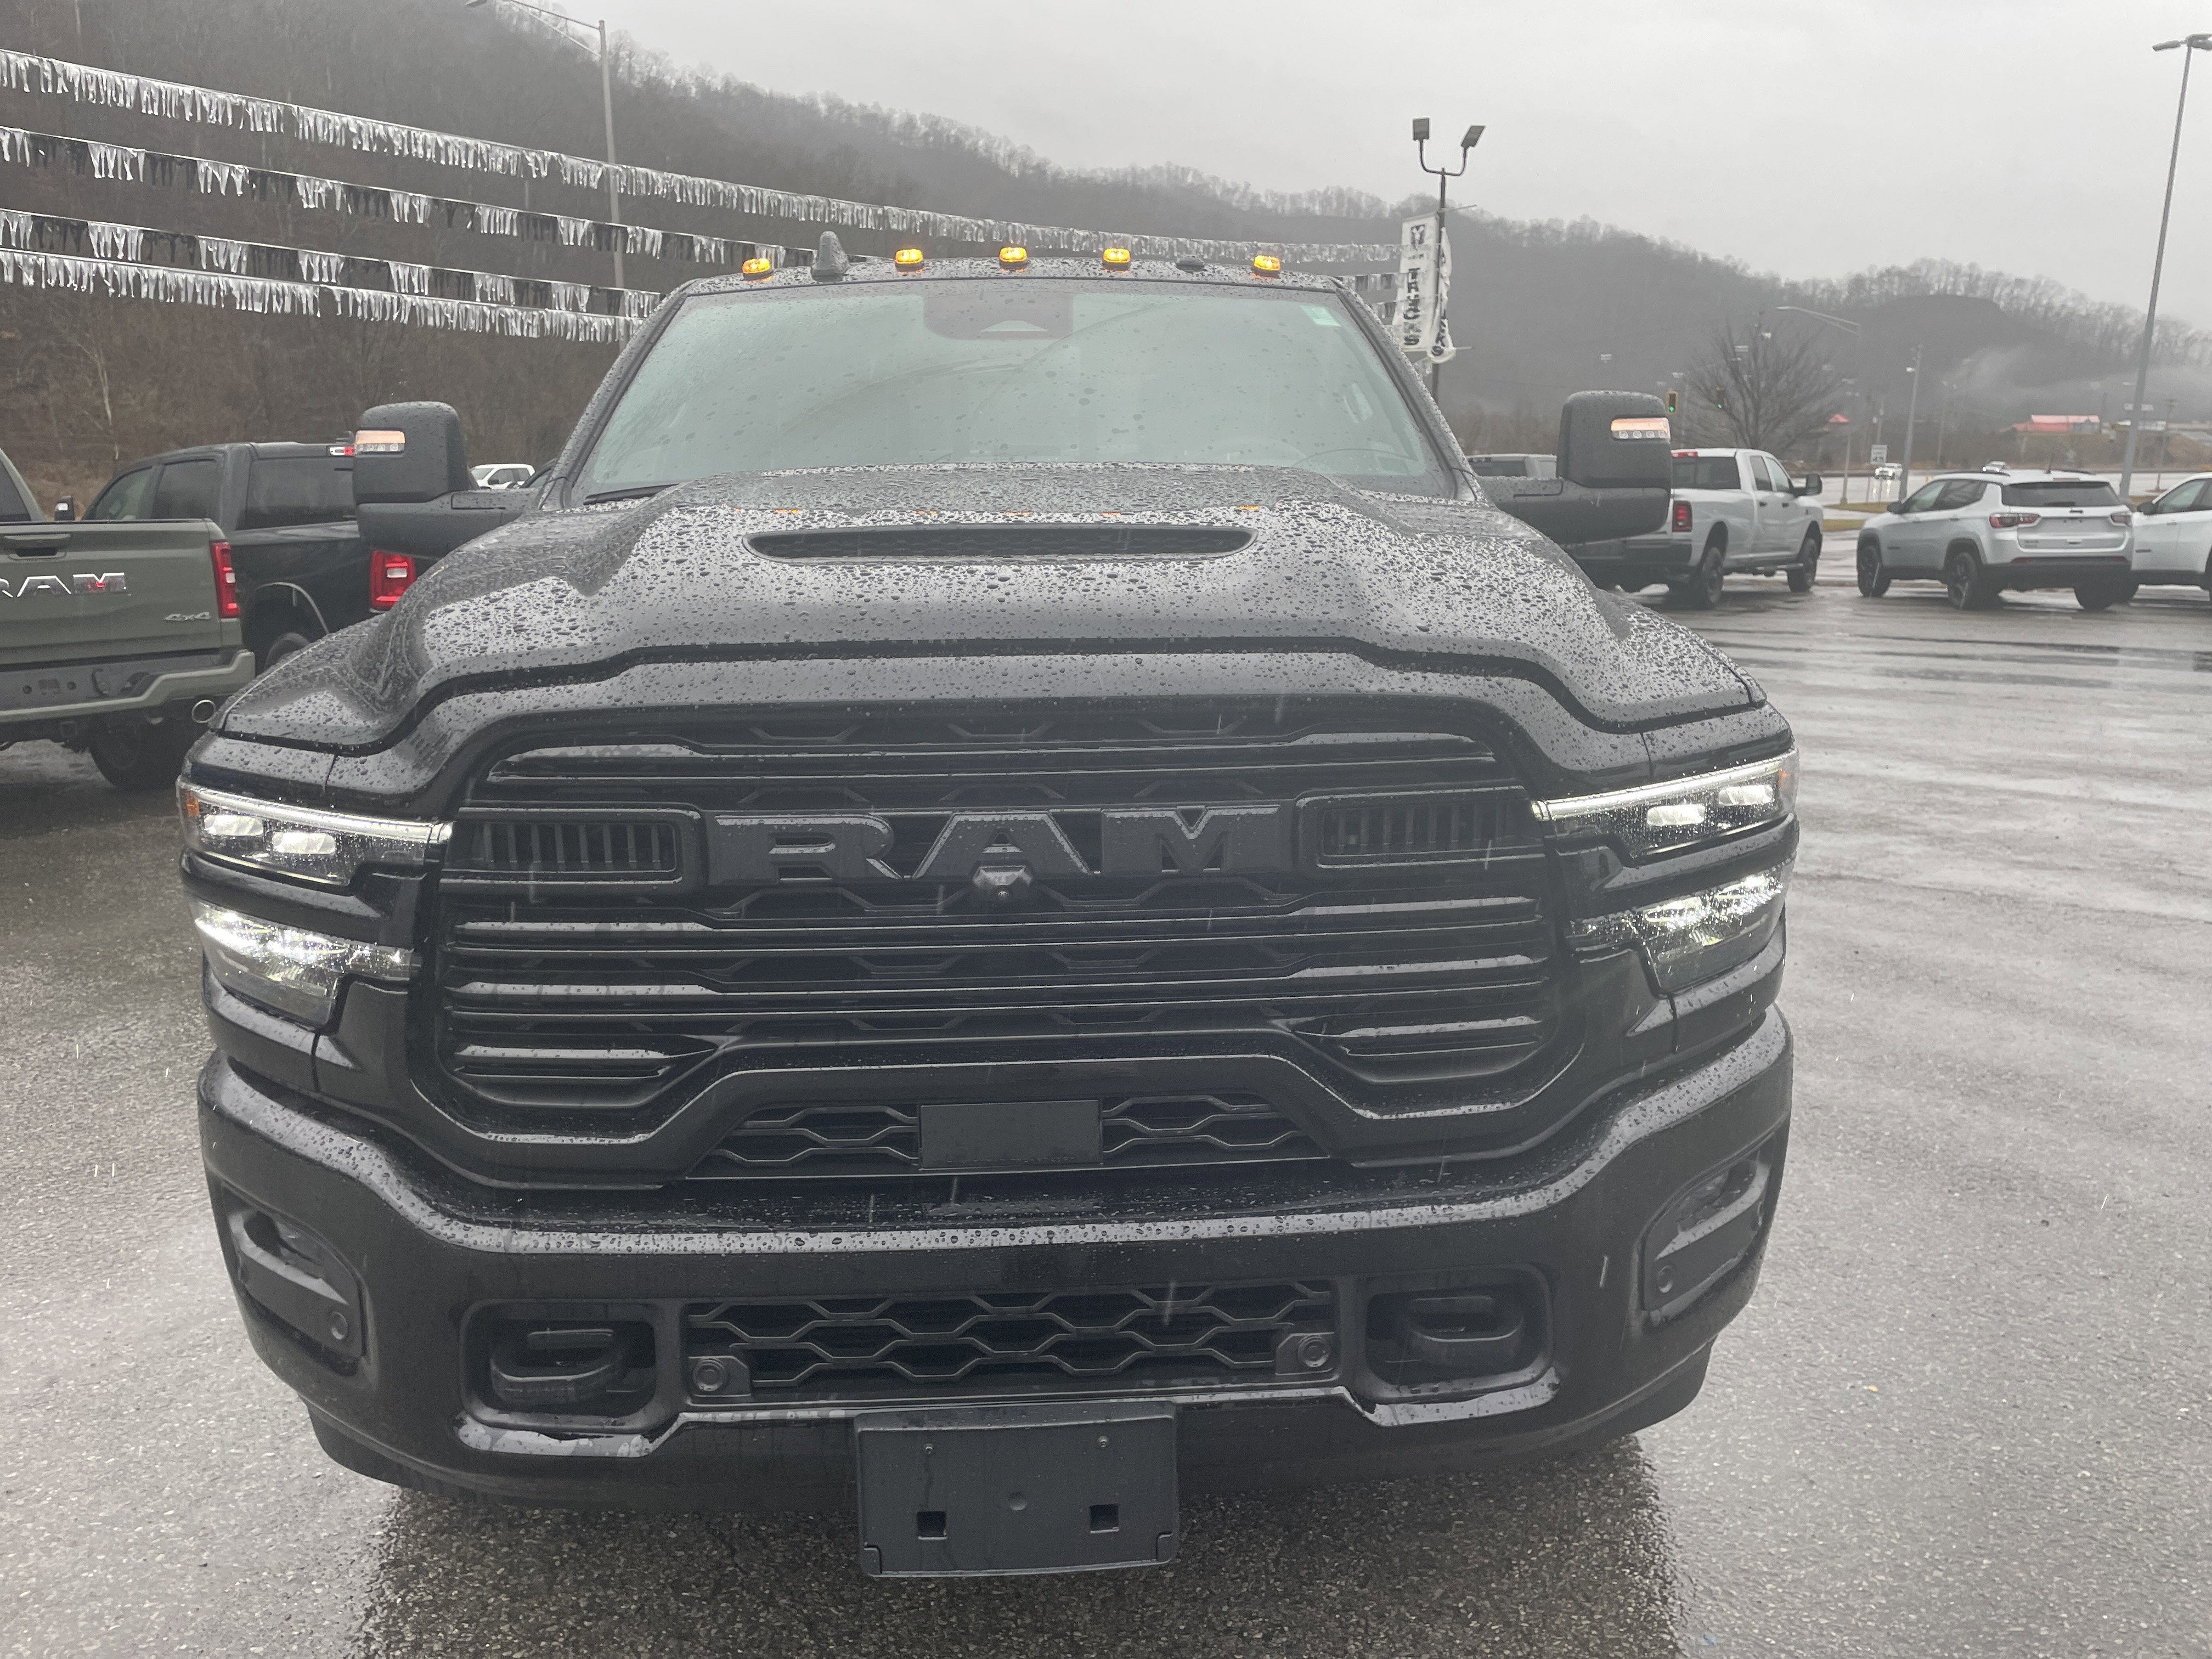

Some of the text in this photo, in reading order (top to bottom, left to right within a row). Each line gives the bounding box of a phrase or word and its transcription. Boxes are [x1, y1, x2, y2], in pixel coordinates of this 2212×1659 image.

[1403, 267, 1421, 346] TRUCKS
[0, 572, 126, 598] AM
[710, 804, 1290, 883] RAM
